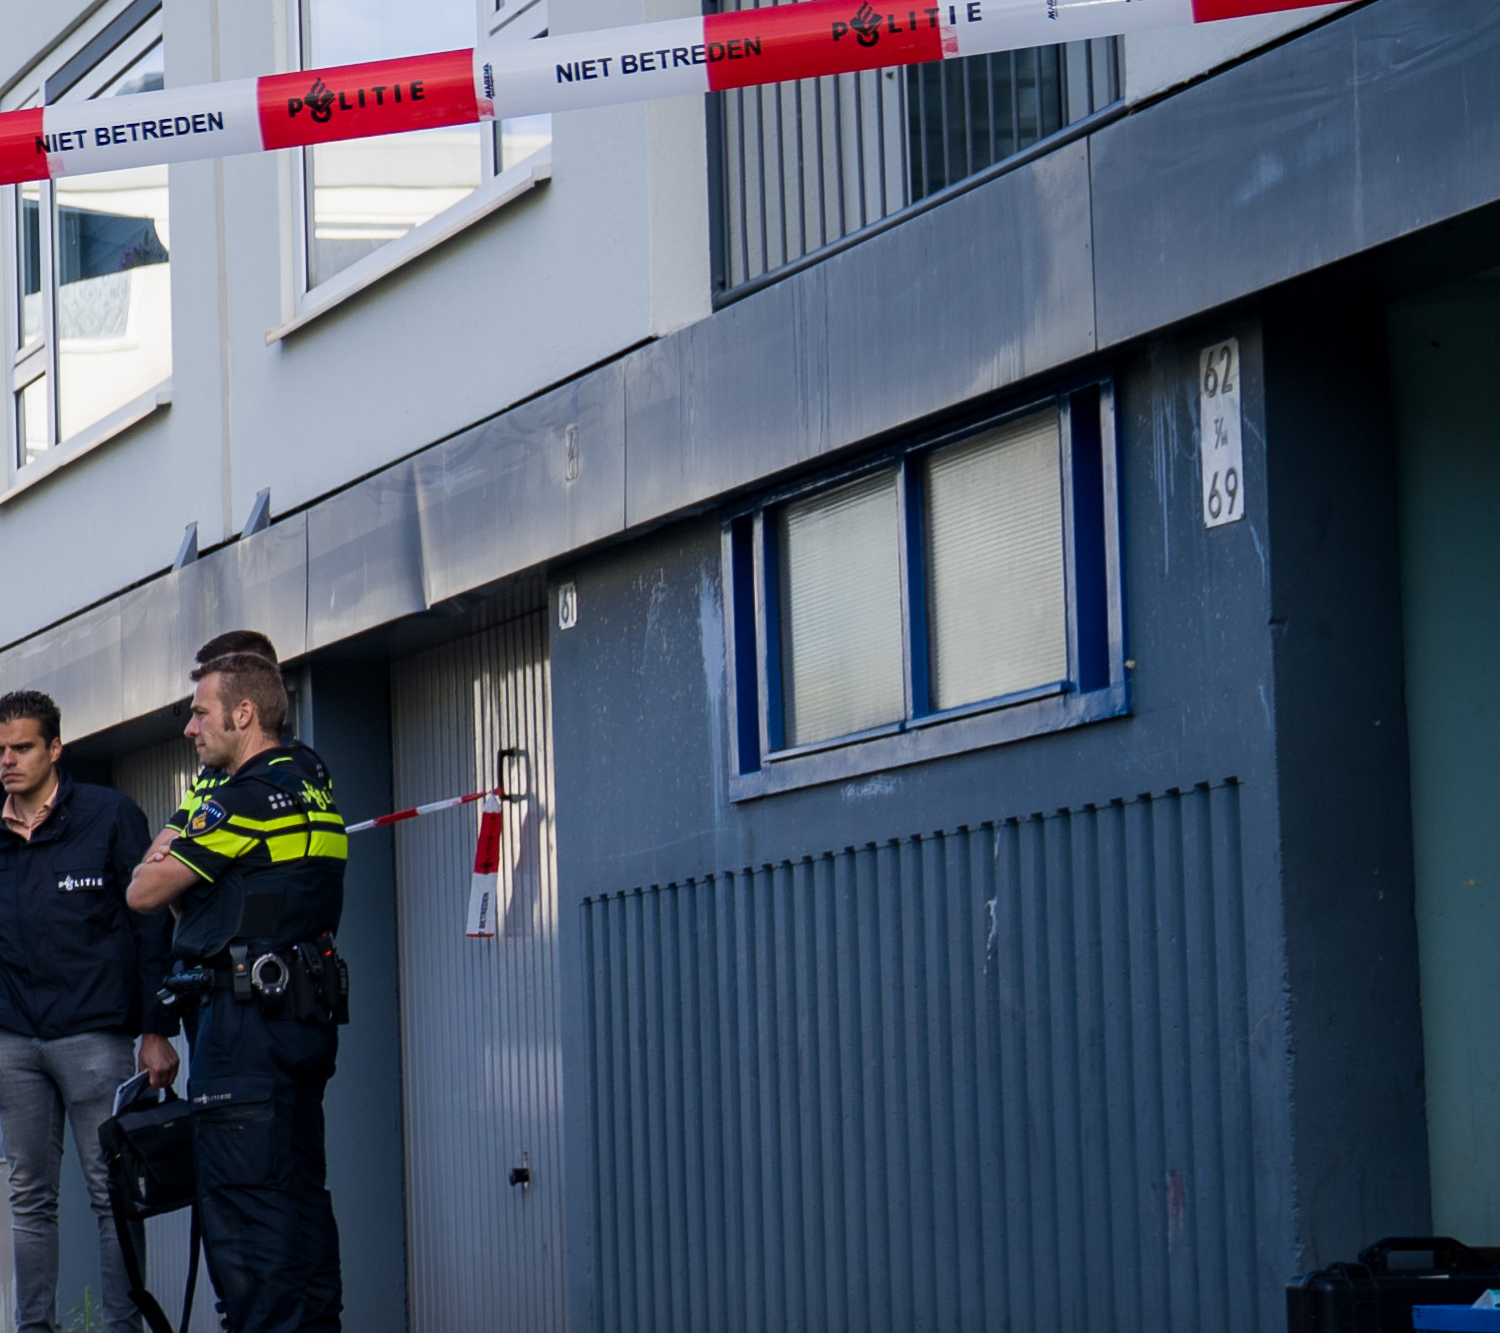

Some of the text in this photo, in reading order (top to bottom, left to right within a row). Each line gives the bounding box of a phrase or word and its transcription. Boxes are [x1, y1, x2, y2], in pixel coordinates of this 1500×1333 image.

[831, 0, 983, 48] POLITIE
[555, 36, 762, 84] NIET BETREDEN
[287, 77, 425, 124] POLITIE
[35, 111, 224, 156] NIET BETREDEN
[1204, 345, 1233, 398] 62
[1208, 467, 1239, 519] 69
[562, 586, 574, 624] 61
